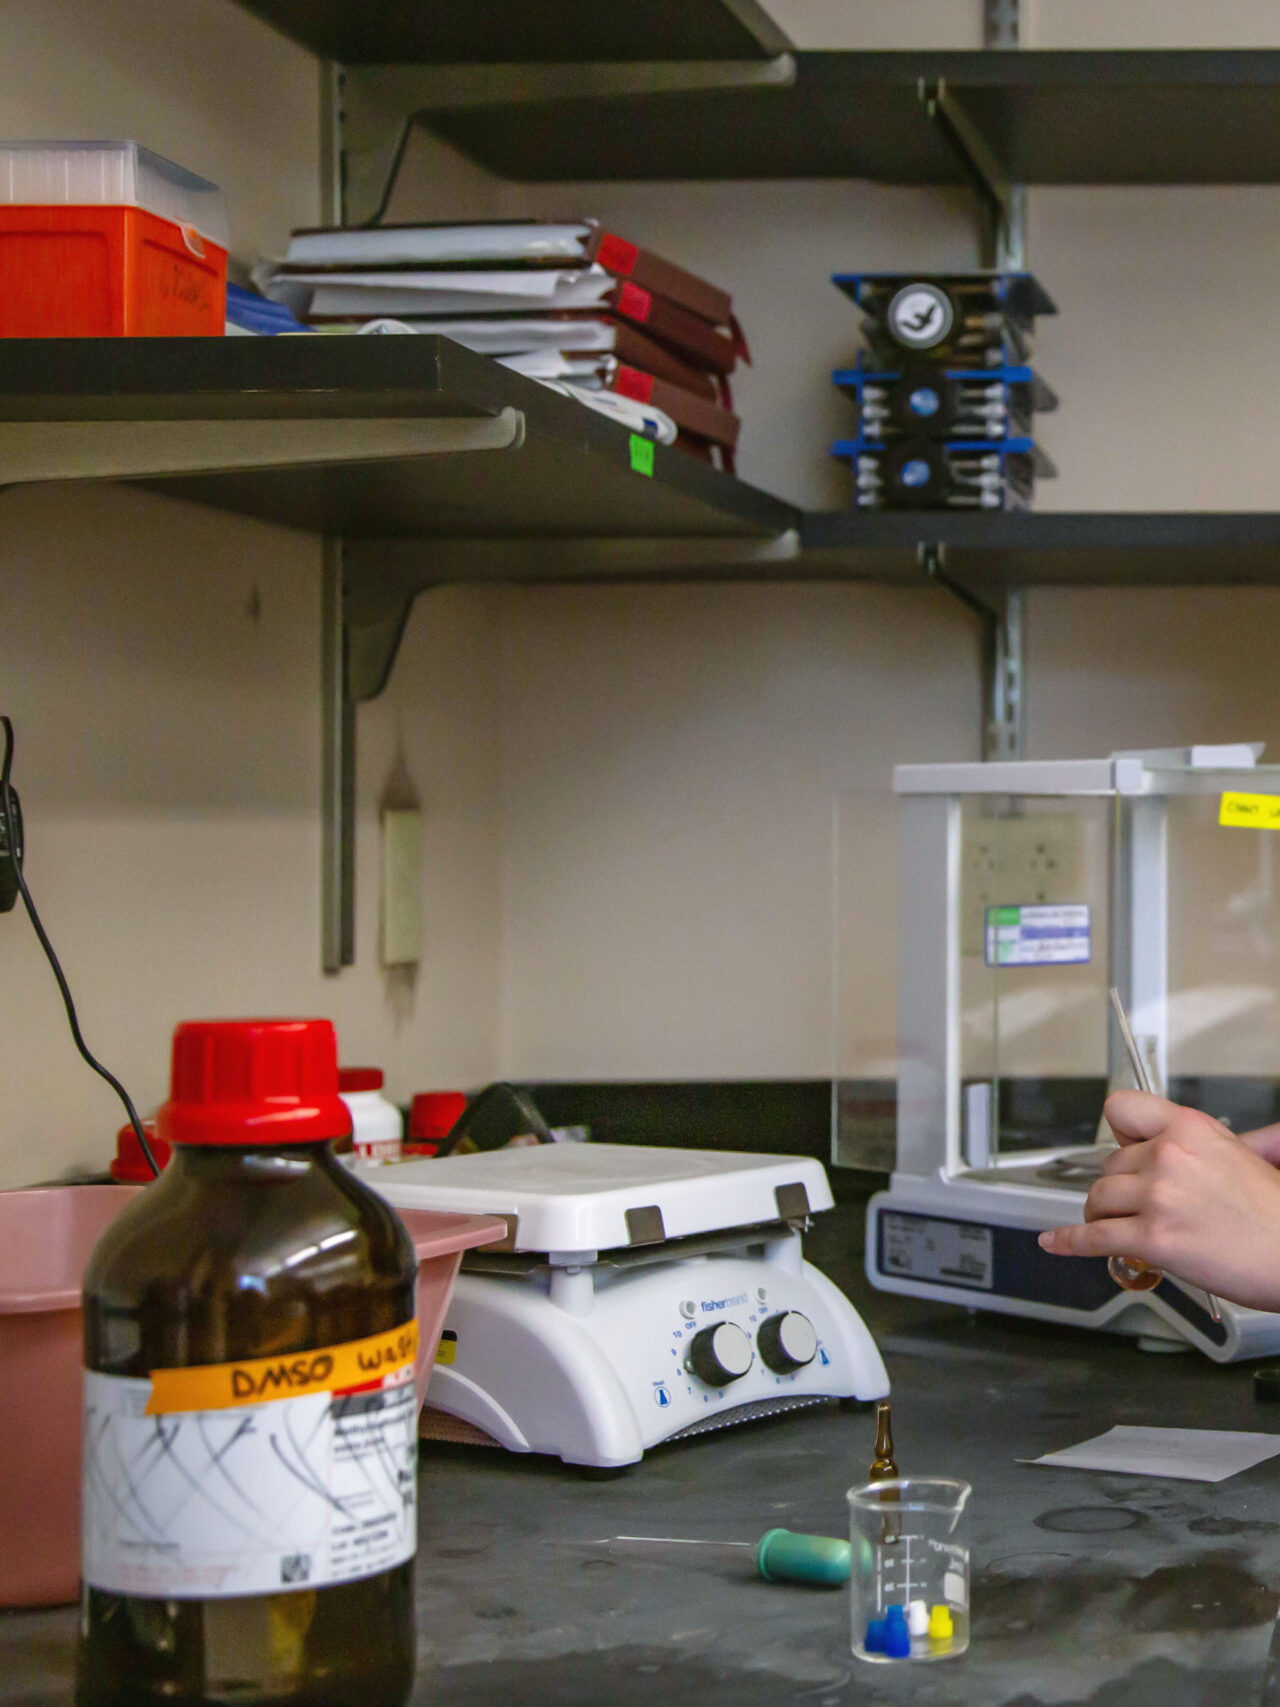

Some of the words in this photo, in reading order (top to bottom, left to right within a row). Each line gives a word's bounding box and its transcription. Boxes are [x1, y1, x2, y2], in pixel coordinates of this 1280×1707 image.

[701, 1295, 748, 1312] fisherbrand
[685, 1321, 697, 1330] OFF
[673, 1330, 683, 1338] 10
[671, 1348, 677, 1356] 9
[233, 1355, 334, 1398] DMSO
[687, 1386, 692, 1395] 7
